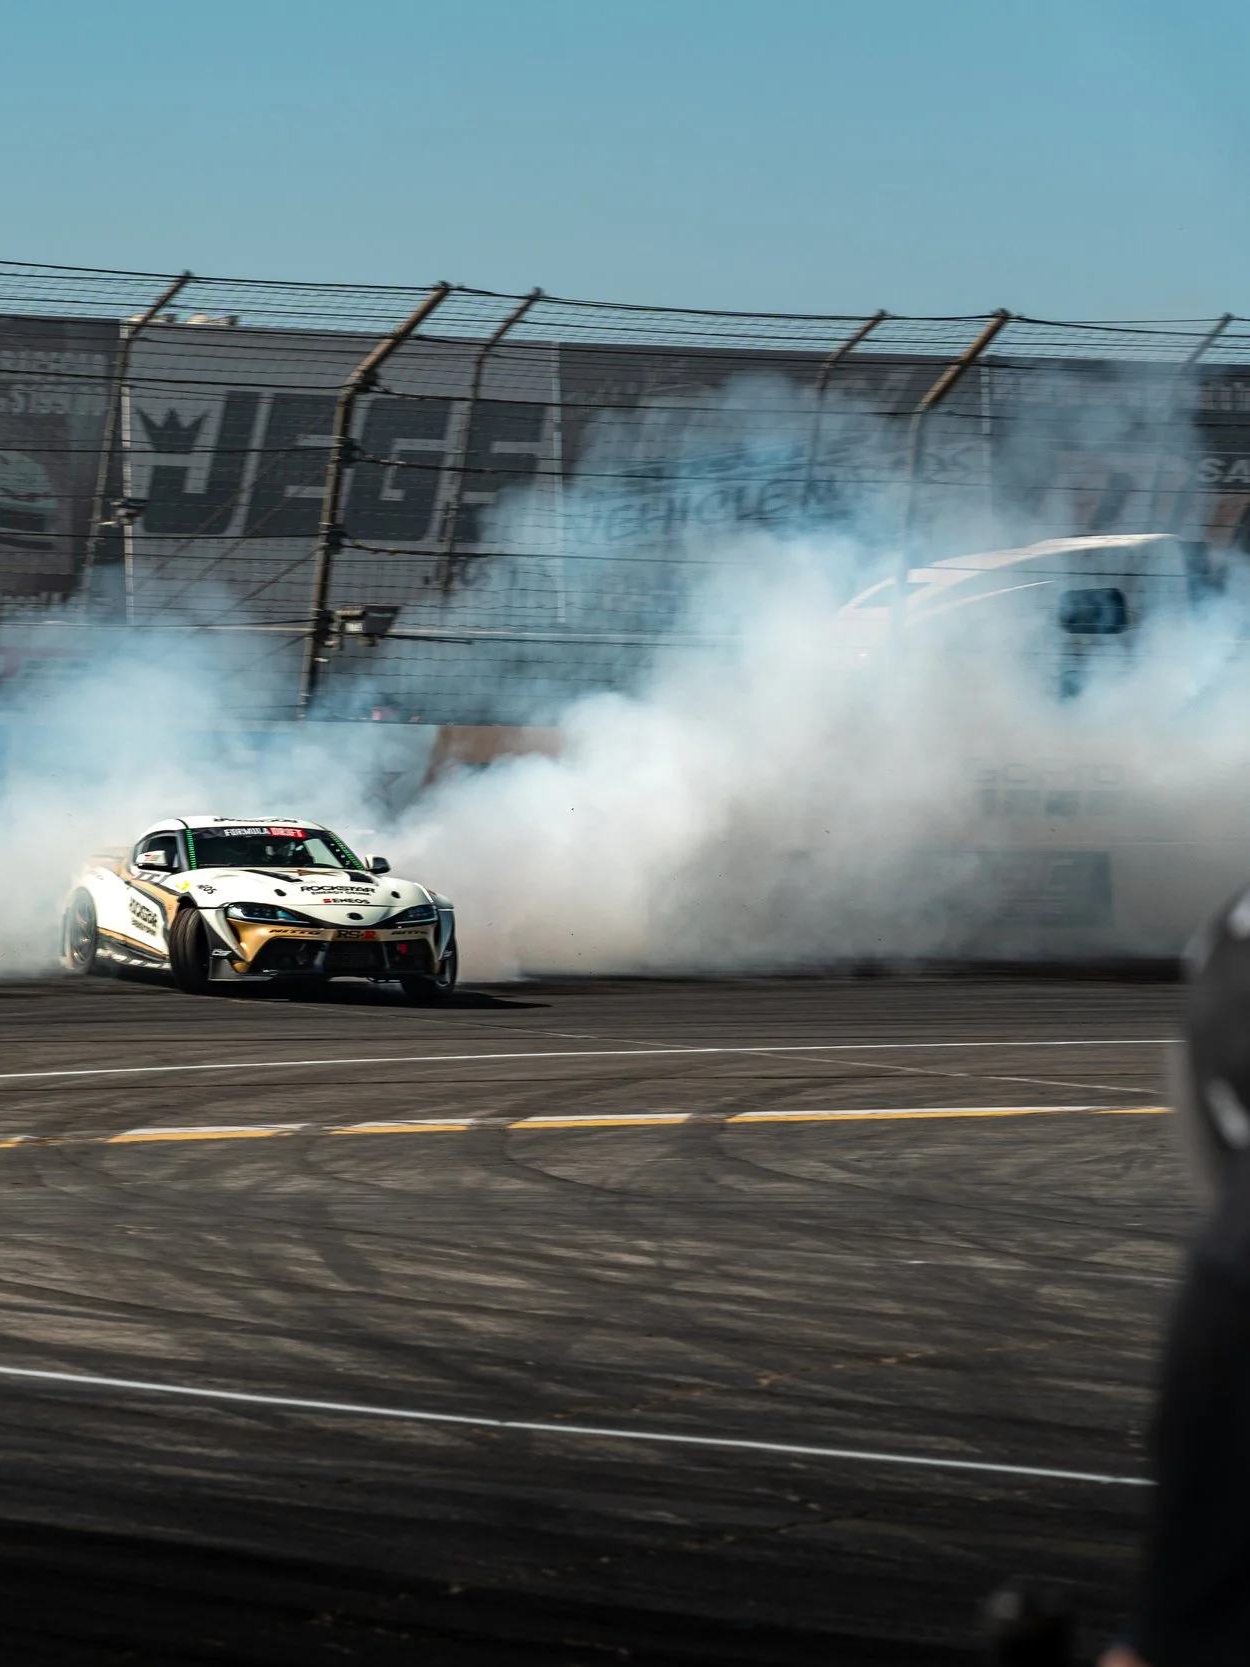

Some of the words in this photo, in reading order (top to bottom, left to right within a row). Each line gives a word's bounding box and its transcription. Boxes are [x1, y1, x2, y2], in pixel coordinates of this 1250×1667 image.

[224, 827, 269, 837] FORMULA
[271, 828, 303, 838] DRIFT
[300, 885, 375, 893] ROCKSTAR
